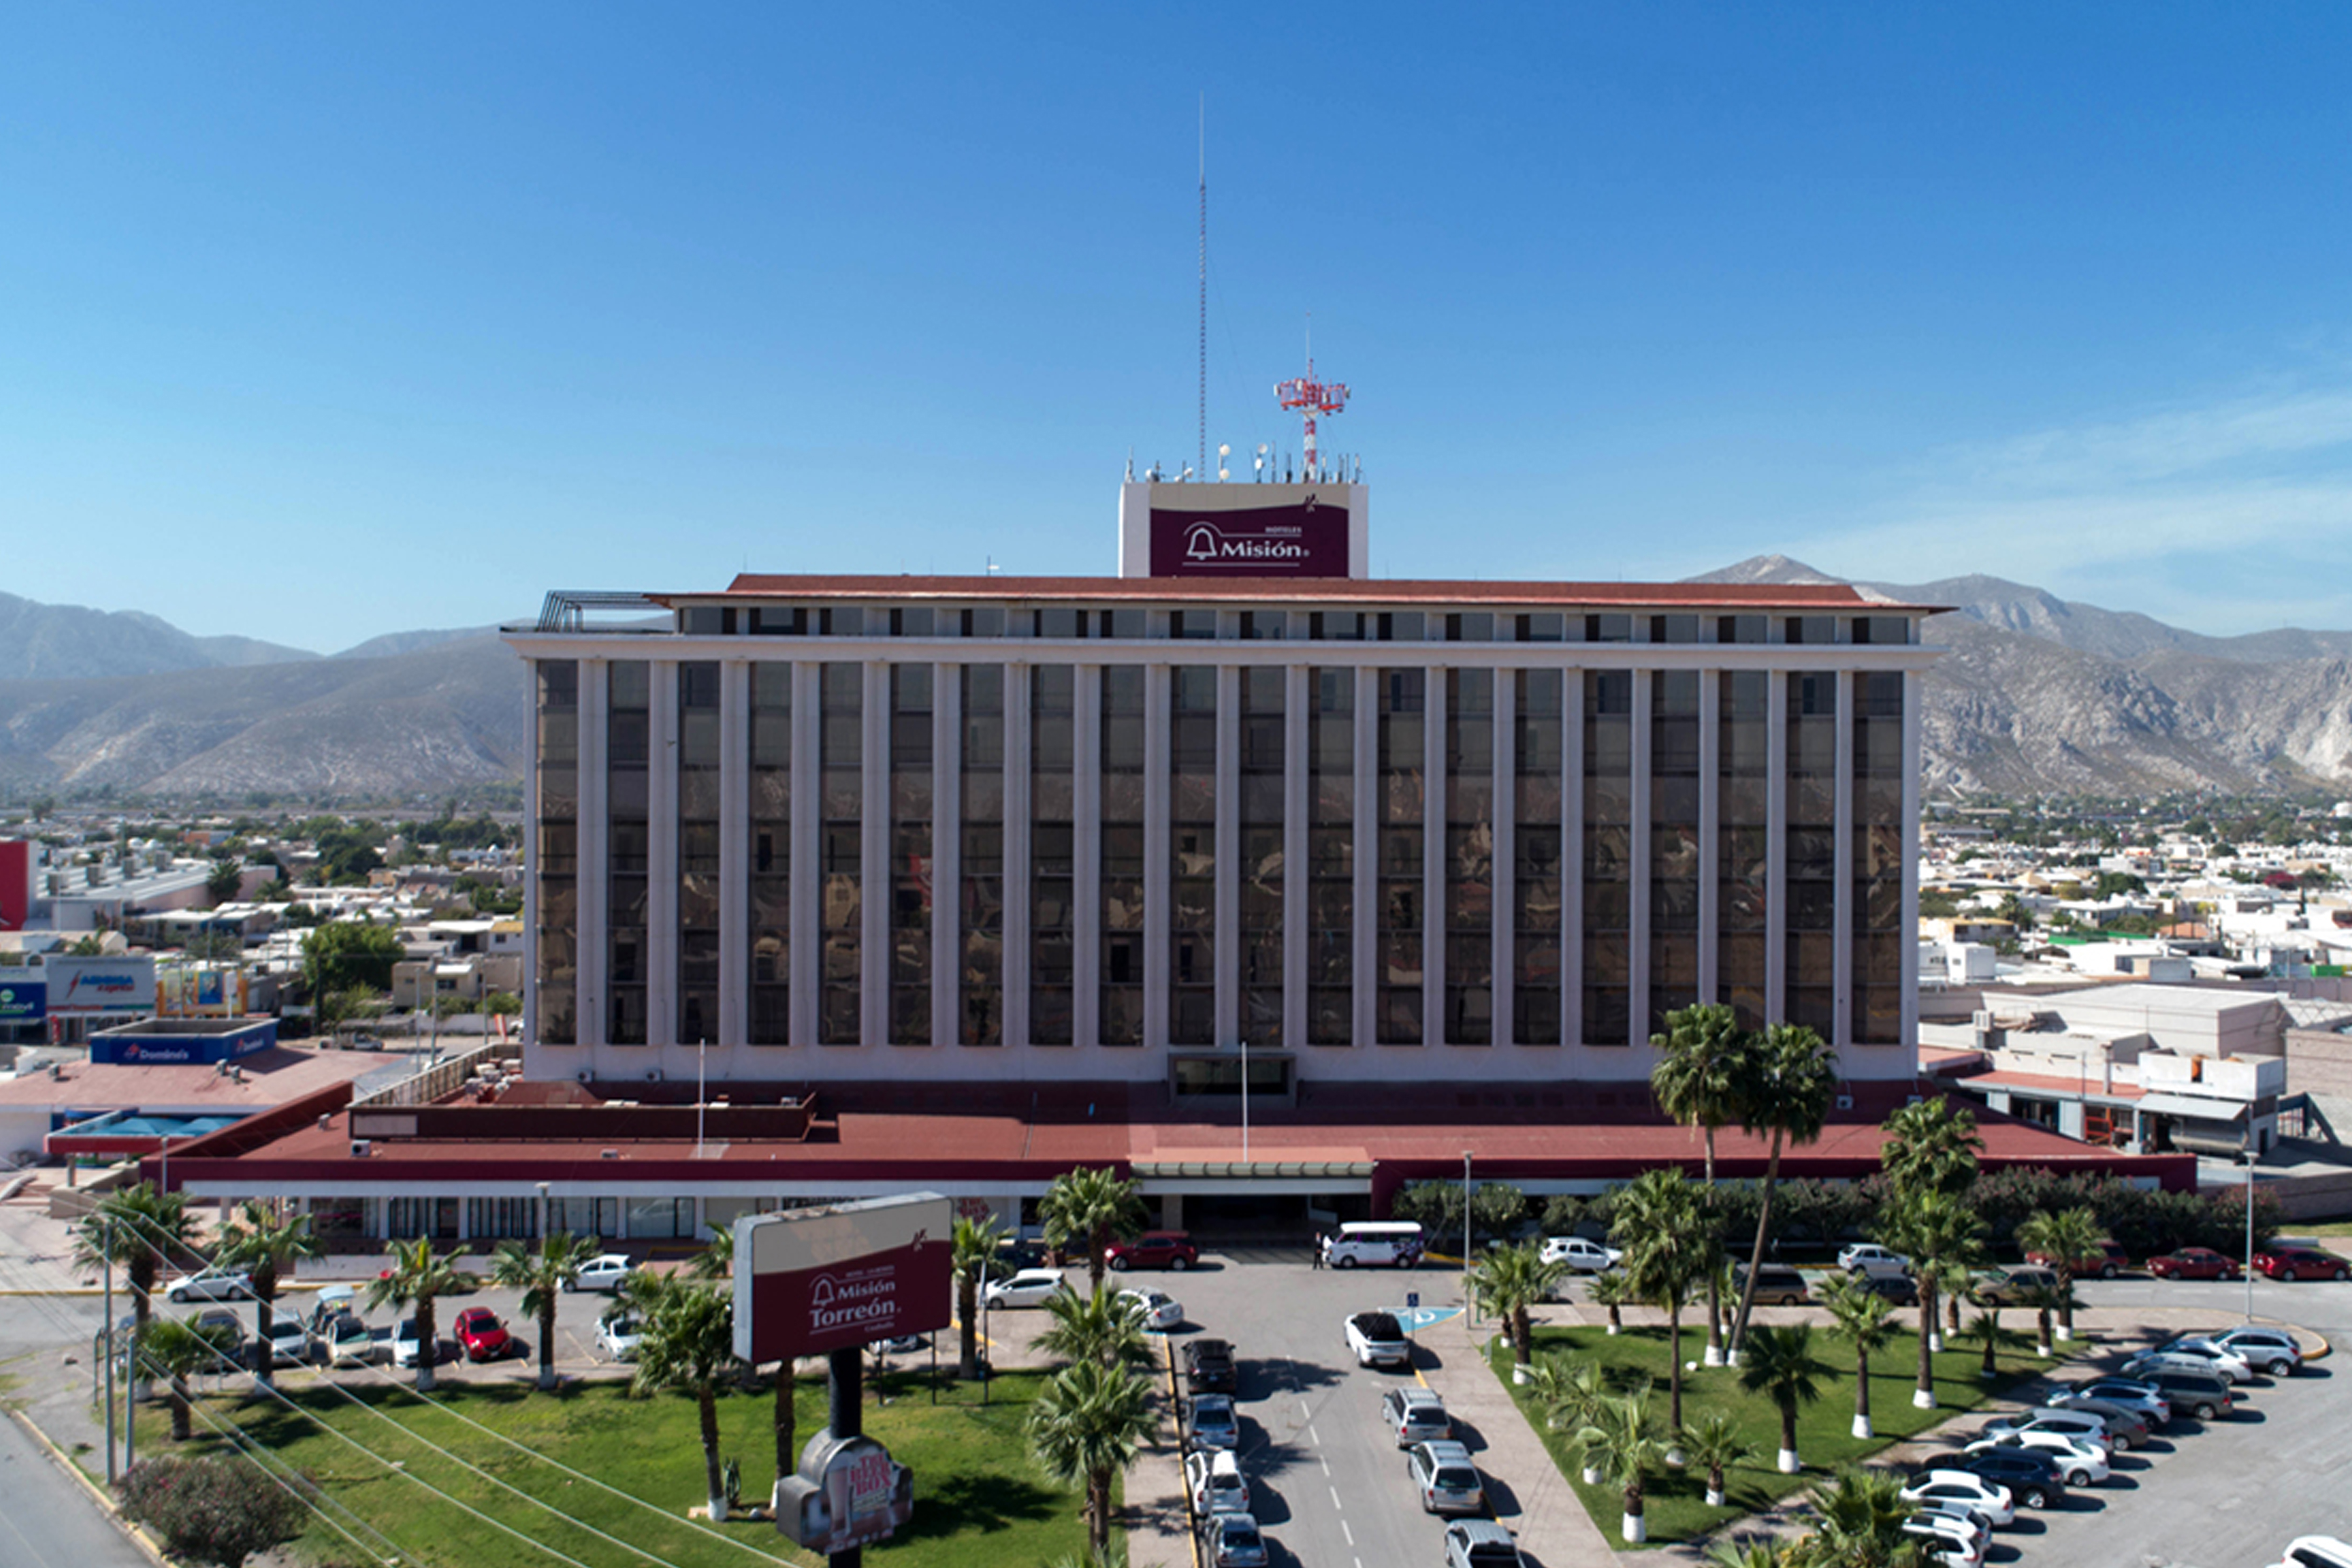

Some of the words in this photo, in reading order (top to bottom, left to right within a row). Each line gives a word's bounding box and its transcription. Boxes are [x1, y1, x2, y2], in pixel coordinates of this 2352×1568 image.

[1221, 540, 1301, 558] Misión
[139, 1048, 189, 1060] Domino's
[837, 1279, 895, 1300] Misión
[809, 1297, 895, 1328] Torreón
[859, 1453, 885, 1468] THE
[850, 1461, 891, 1482] BEER
[856, 1473, 892, 1496] BOX
